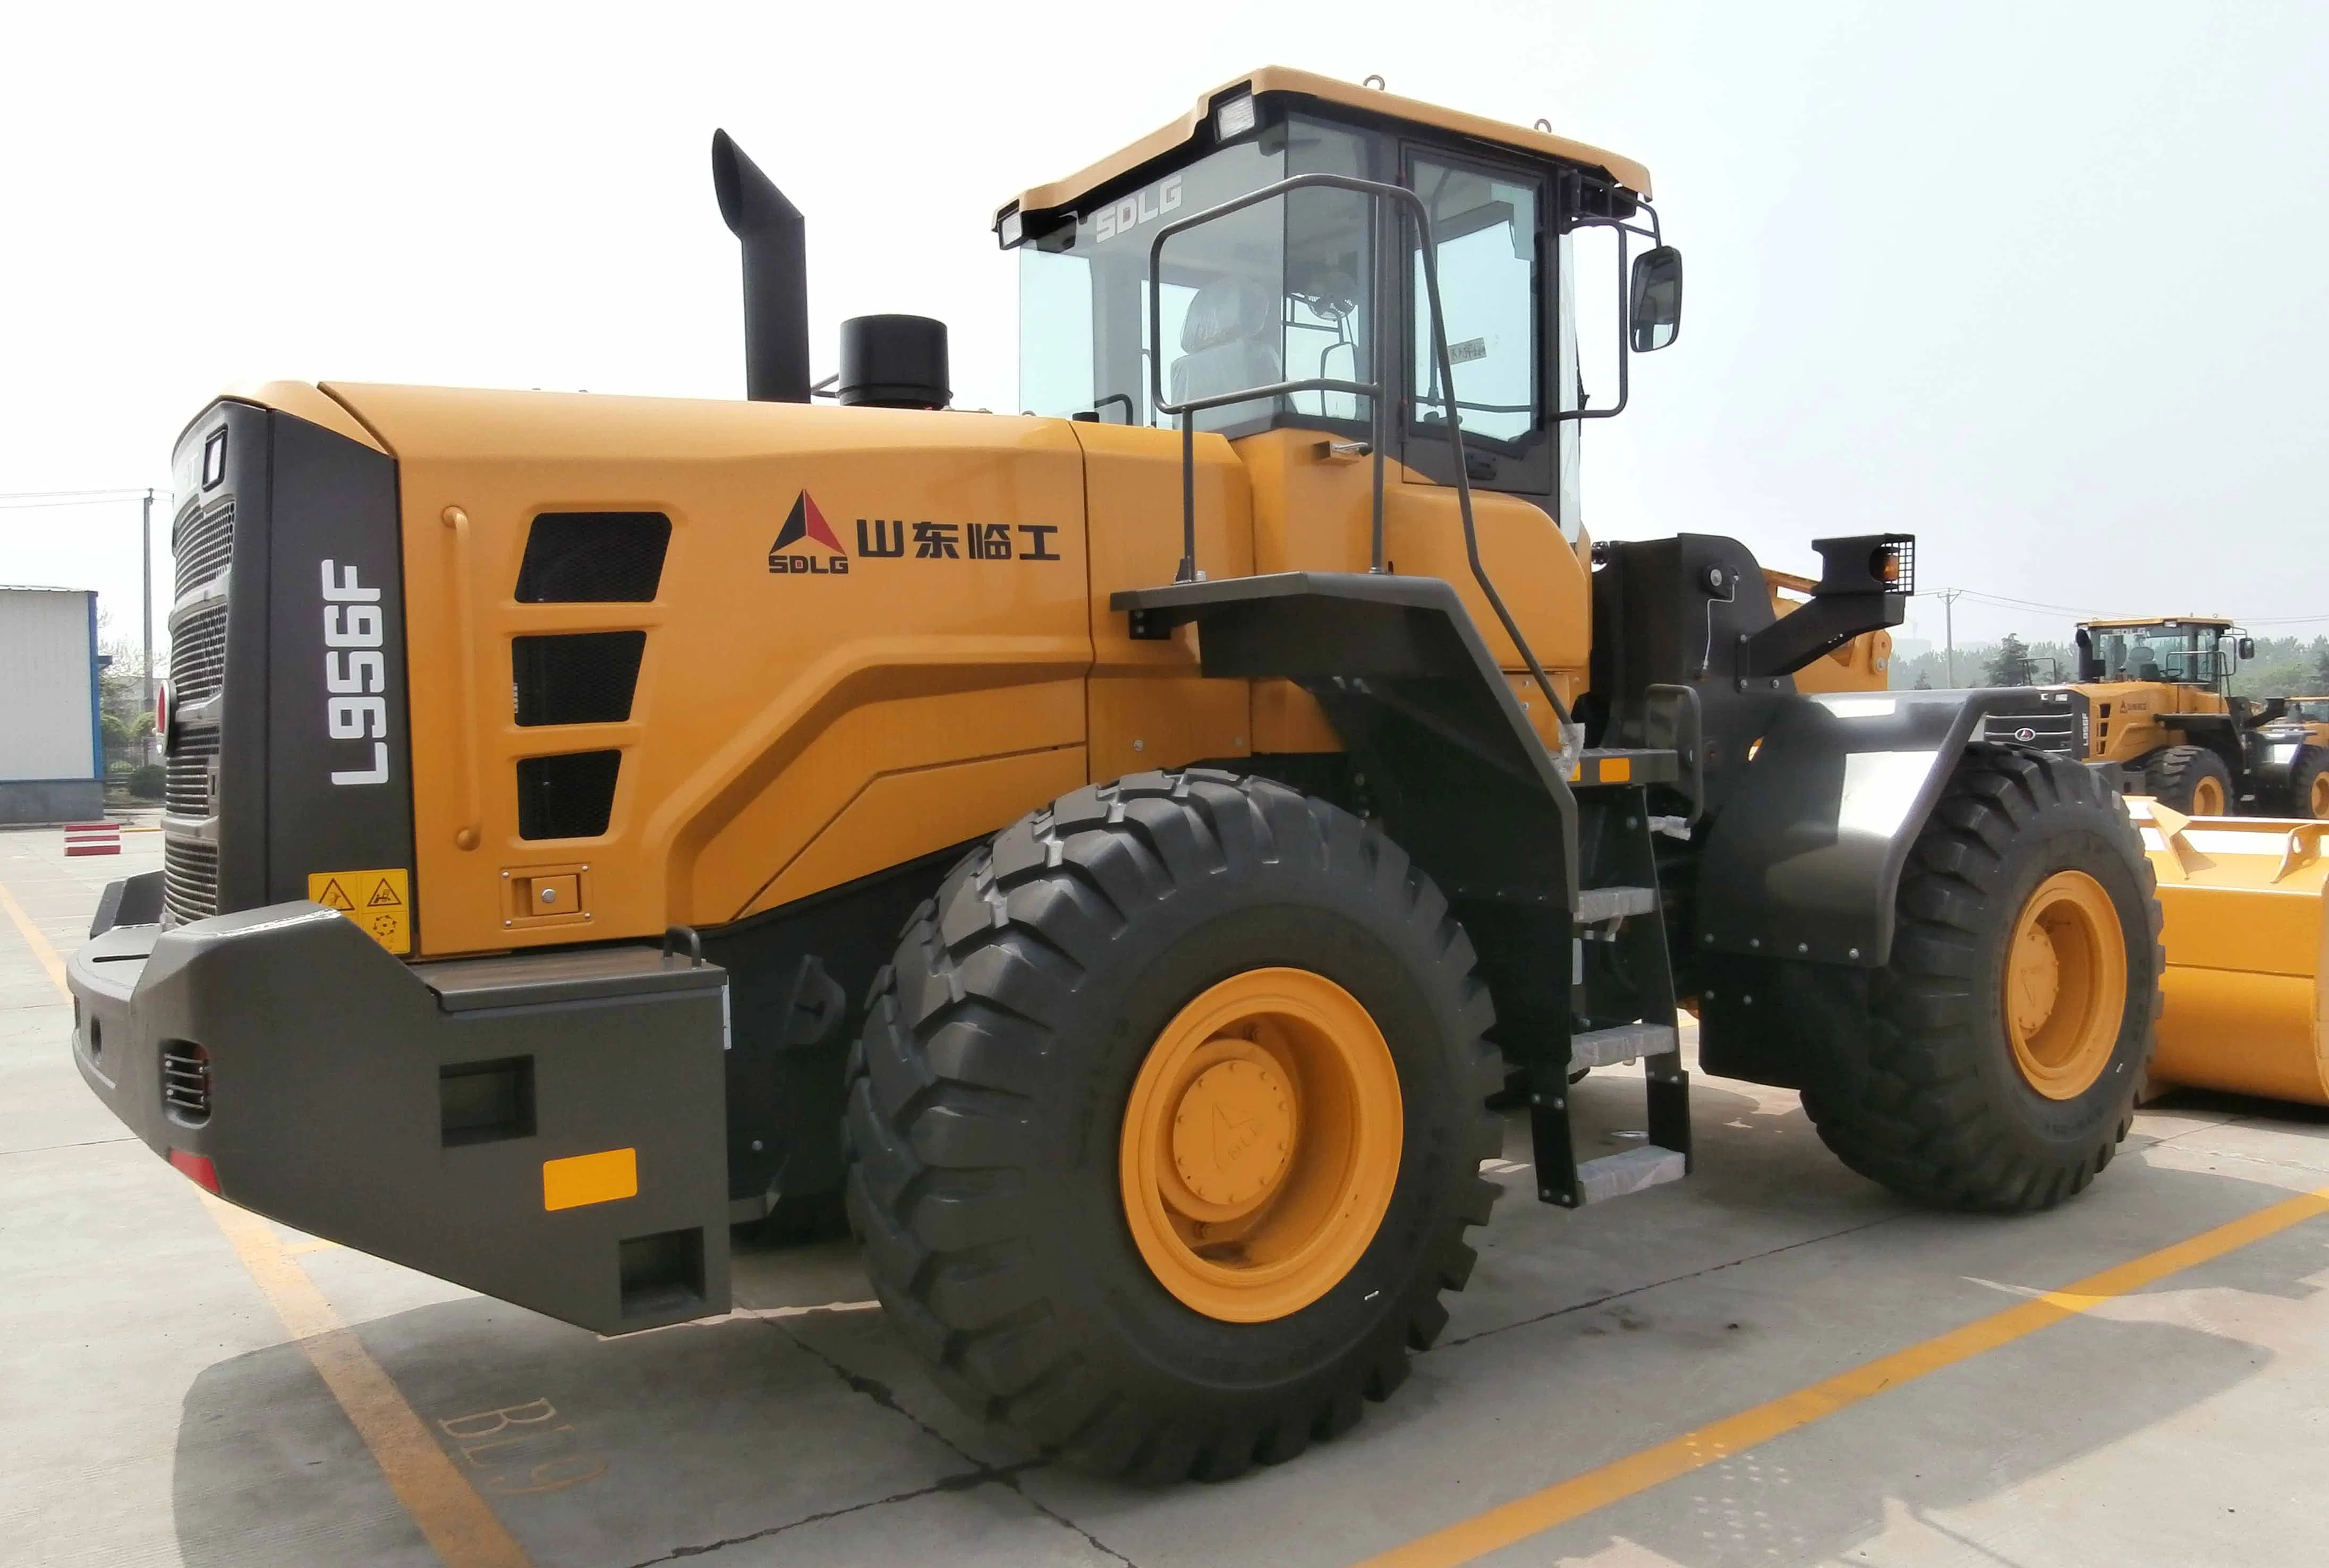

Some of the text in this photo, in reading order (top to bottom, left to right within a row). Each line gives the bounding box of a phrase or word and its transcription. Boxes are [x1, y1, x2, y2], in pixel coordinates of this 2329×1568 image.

[1096, 174, 1183, 243] SDLG
[768, 555, 849, 574] SDLG
[856, 518, 1061, 561] 山东临工
[321, 559, 389, 786] L956F
